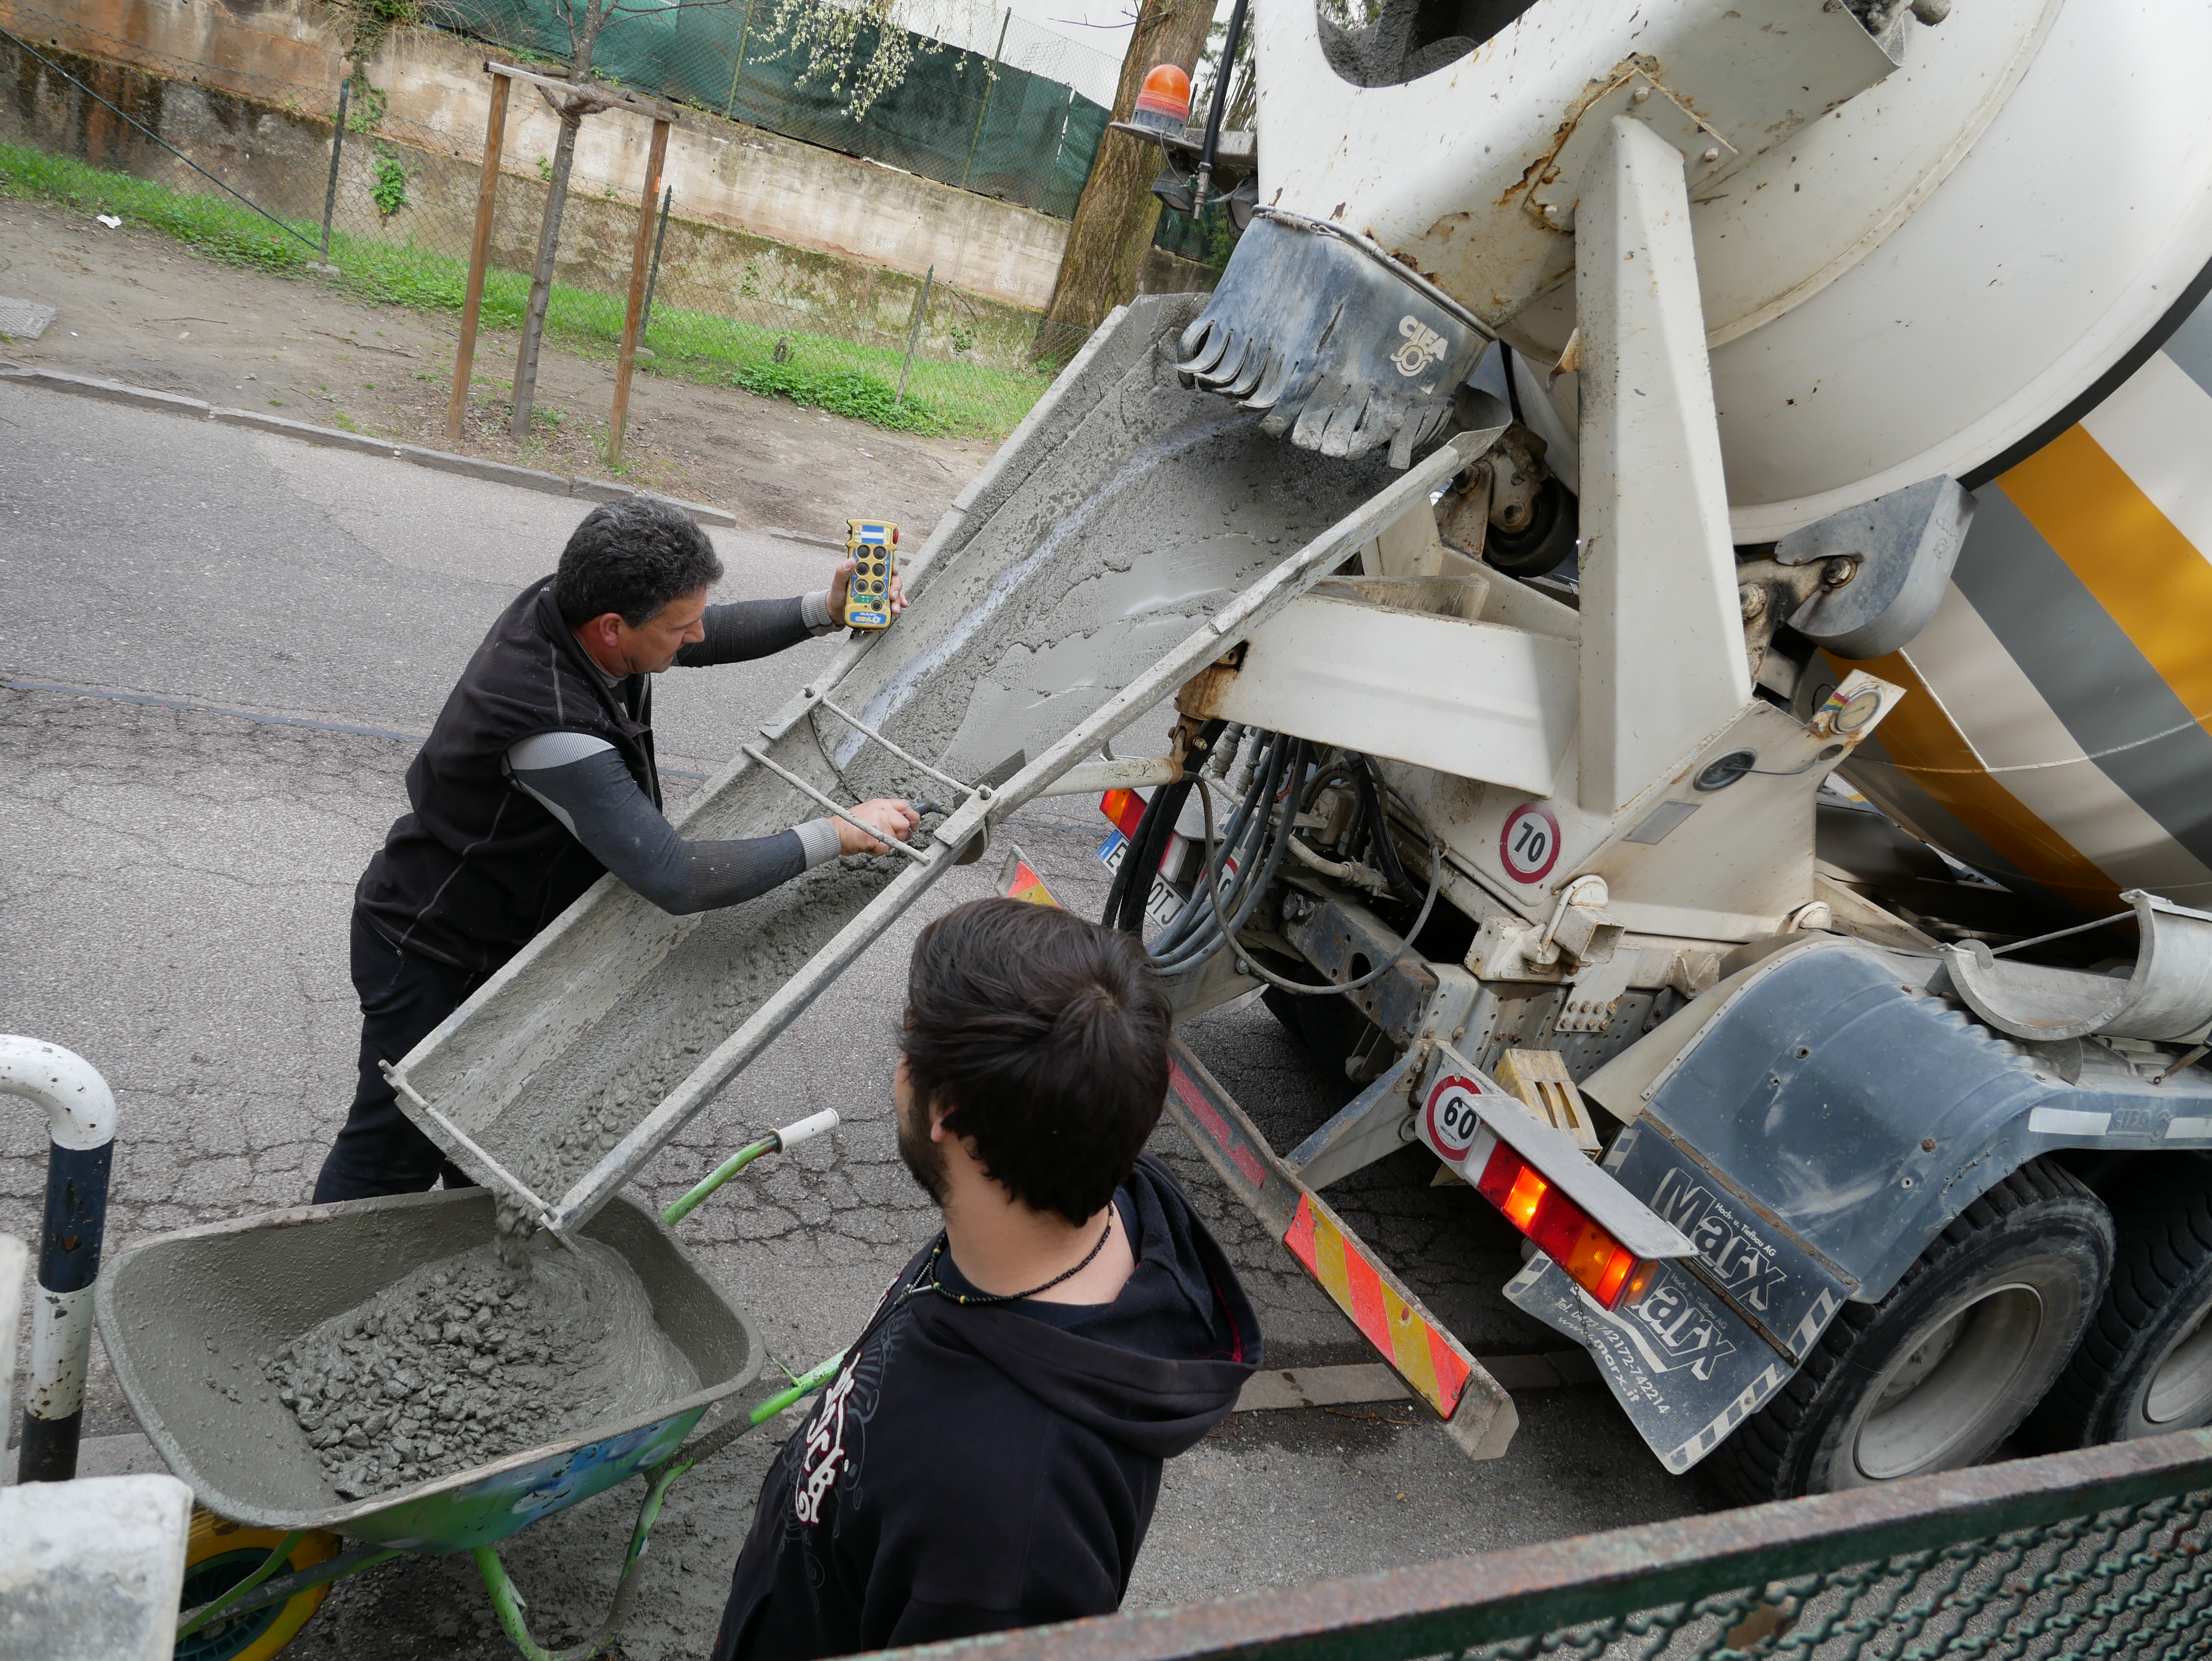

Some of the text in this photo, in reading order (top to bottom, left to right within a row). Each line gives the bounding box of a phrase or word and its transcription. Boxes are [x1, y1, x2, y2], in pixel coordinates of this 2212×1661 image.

[1398, 315, 1448, 362] CIFA
[1514, 821, 1546, 863] 70
[1444, 1096, 1477, 1140] 60
[2111, 1108, 2151, 1129] CIFA
[1714, 1202, 1777, 1257] Hoch- u. Tiefbau AG
[1630, 1259, 1737, 1381] arx
[1670, 1273, 1687, 1291] Hoch-
[1695, 1296, 1716, 1319] Tiefbau
[1715, 1318, 1728, 1330] AG
[1555, 1297, 1573, 1313] Tel.
[1597, 1325, 1671, 1414] 742172-742214
